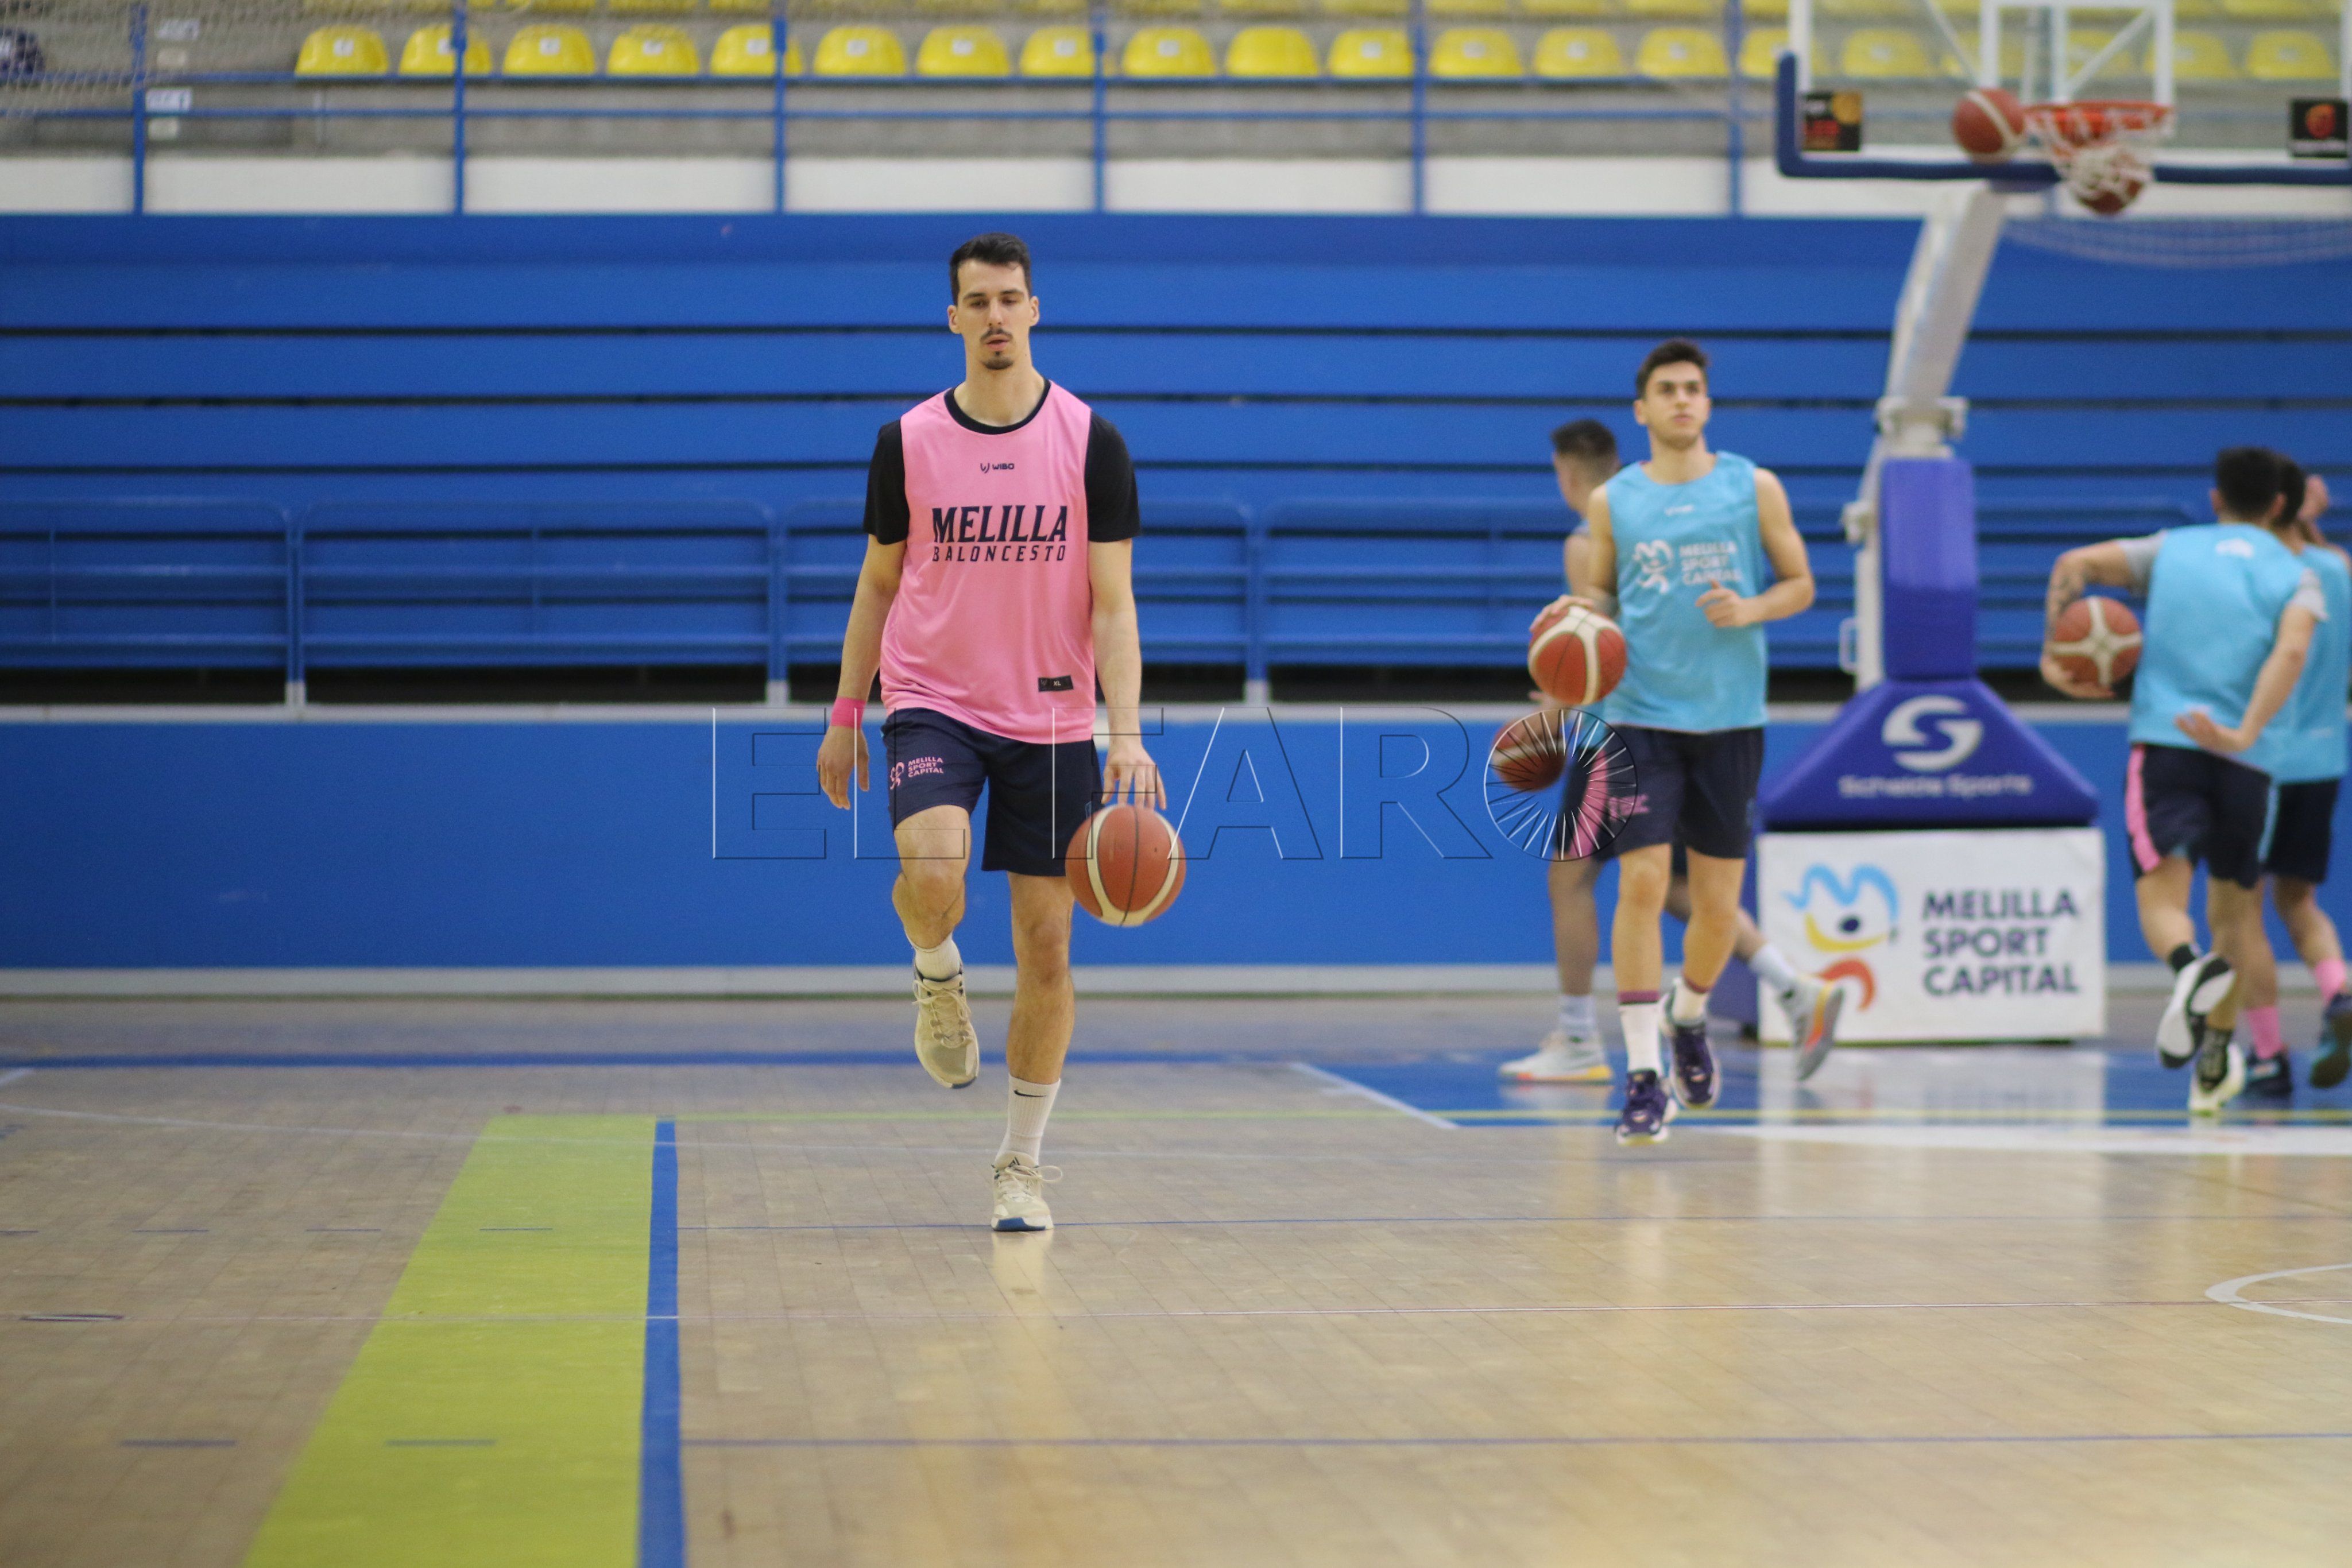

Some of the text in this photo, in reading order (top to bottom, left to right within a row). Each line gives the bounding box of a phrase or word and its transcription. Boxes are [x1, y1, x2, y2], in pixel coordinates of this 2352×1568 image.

[932, 505, 1067, 543] MELILLA
[932, 545, 1066, 562] BALONCESTO
[908, 756, 943, 766] MELILLA
[908, 762, 937, 772] SPORT
[908, 767, 943, 778] CAPITAL
[1923, 888, 2078, 920] MELILLA
[1924, 927, 2049, 959] SPORT
[1923, 963, 2079, 996] CAPITAL
